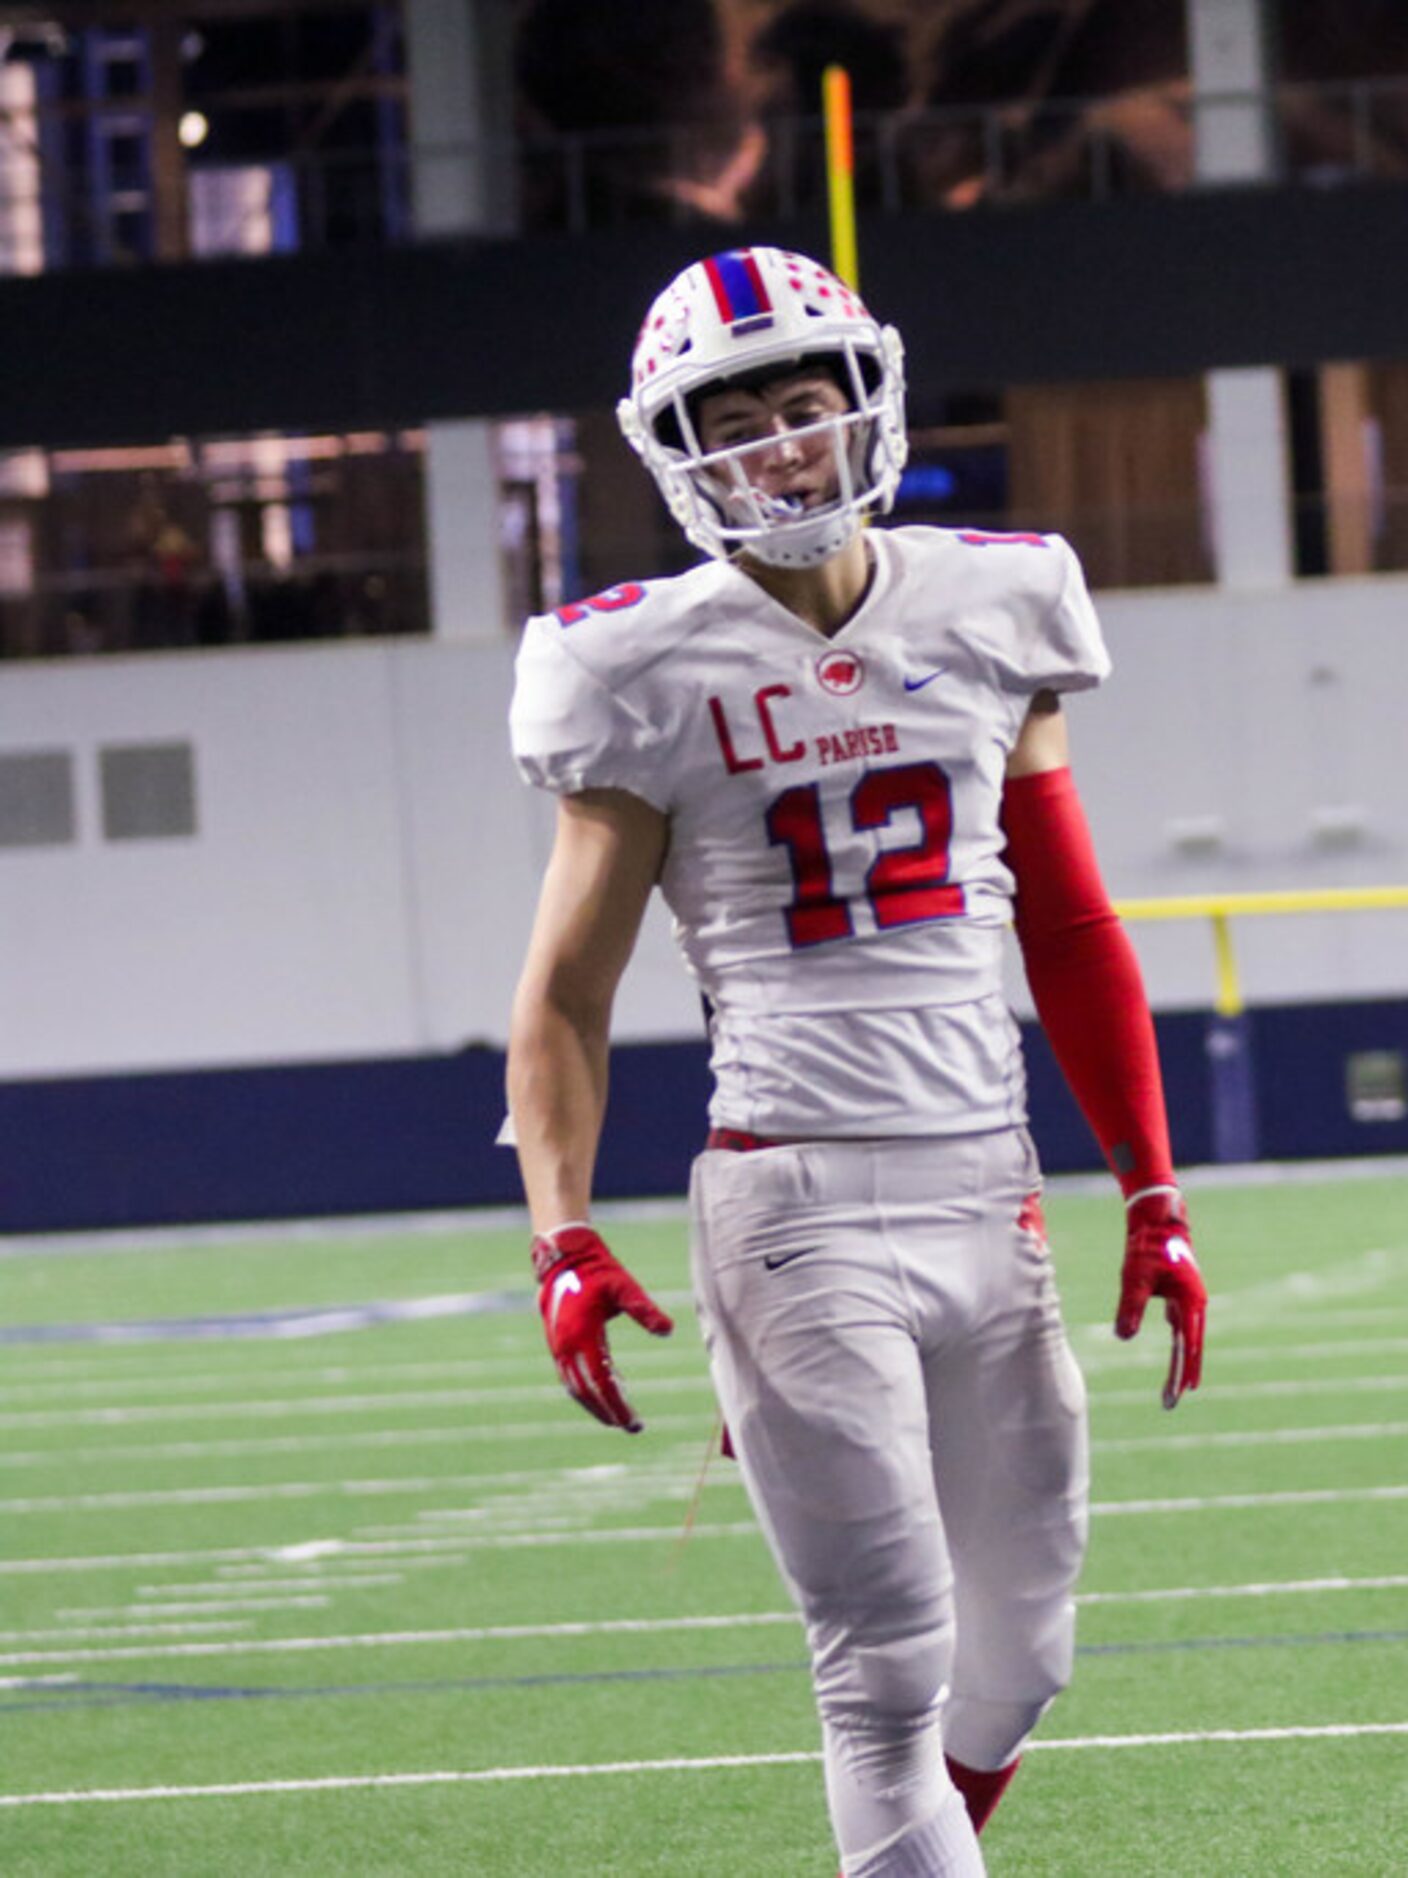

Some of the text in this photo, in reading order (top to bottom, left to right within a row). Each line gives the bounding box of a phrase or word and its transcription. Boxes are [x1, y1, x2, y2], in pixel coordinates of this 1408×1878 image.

[709, 685, 900, 774] LC PARISH
[766, 762, 965, 949] 12
